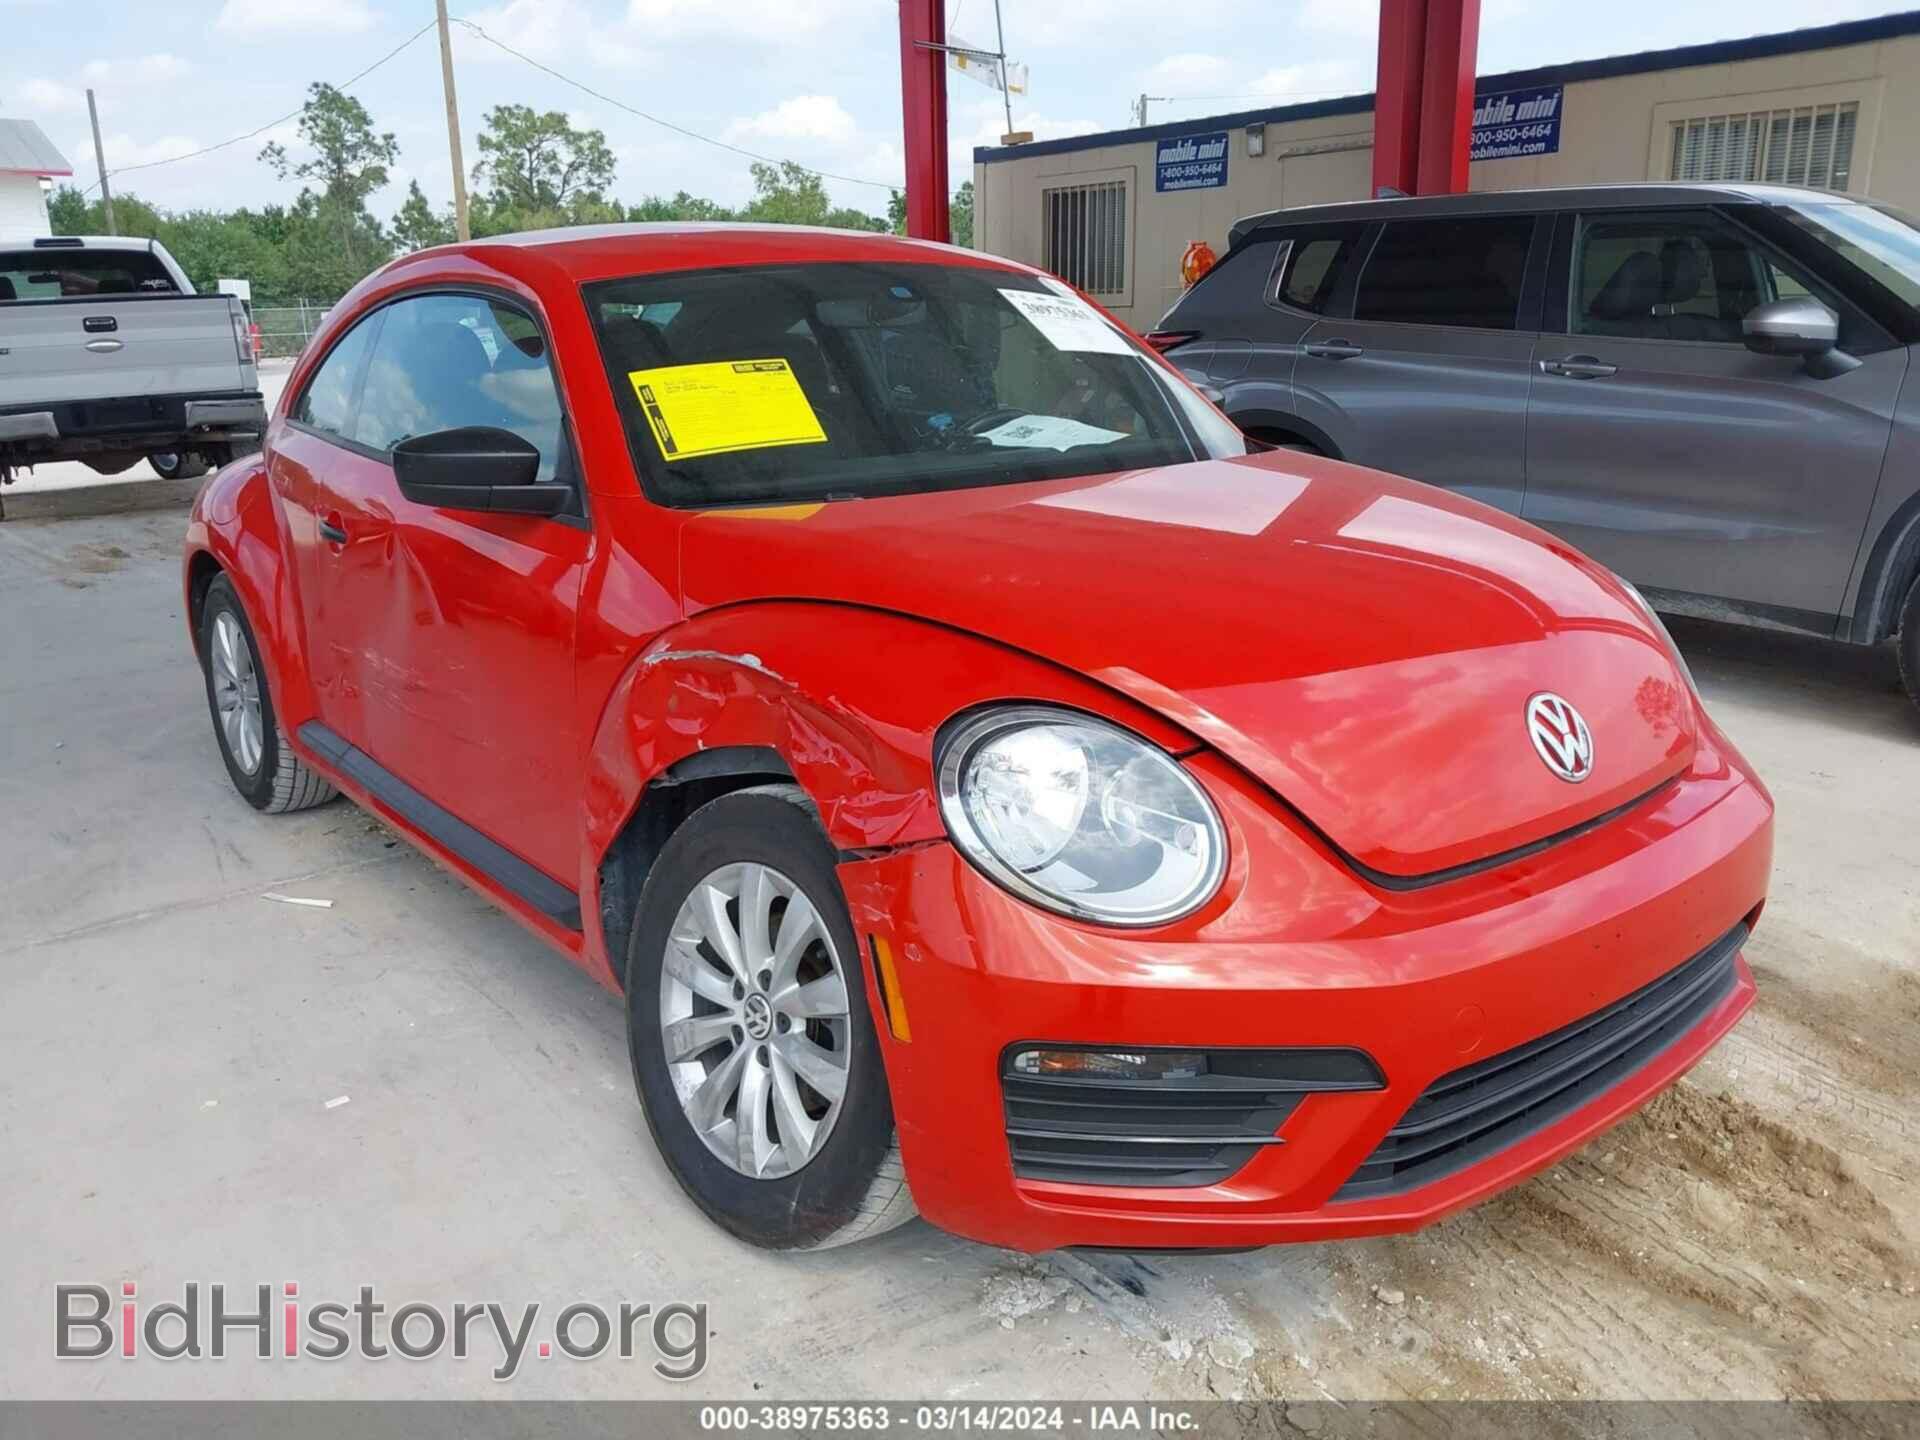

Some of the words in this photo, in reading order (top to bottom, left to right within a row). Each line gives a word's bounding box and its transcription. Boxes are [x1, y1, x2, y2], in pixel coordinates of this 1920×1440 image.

[1515, 92, 1559, 121] mini
[1159, 139, 1198, 164] mobile
[1198, 138, 1227, 159] mini
